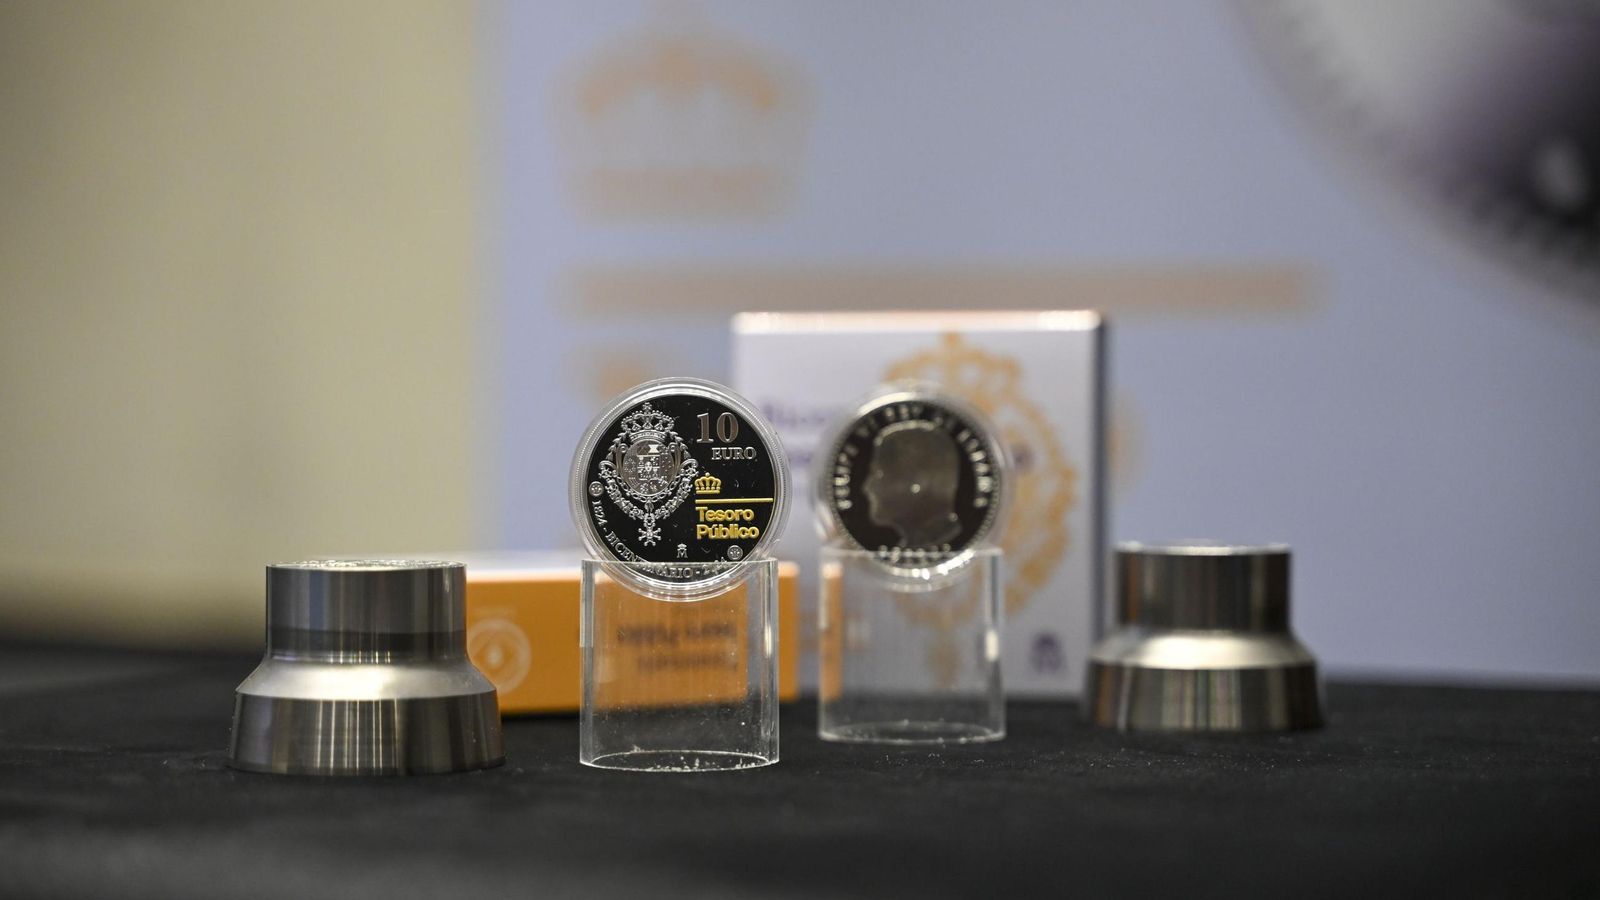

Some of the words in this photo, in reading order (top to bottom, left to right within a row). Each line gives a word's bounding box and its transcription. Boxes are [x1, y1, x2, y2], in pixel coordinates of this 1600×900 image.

[696, 411, 739, 444] 10
[711, 446, 757, 460] EURO
[591, 501, 605, 527] 1824
[695, 506, 755, 522] Tesoro
[695, 523, 760, 541] Público
